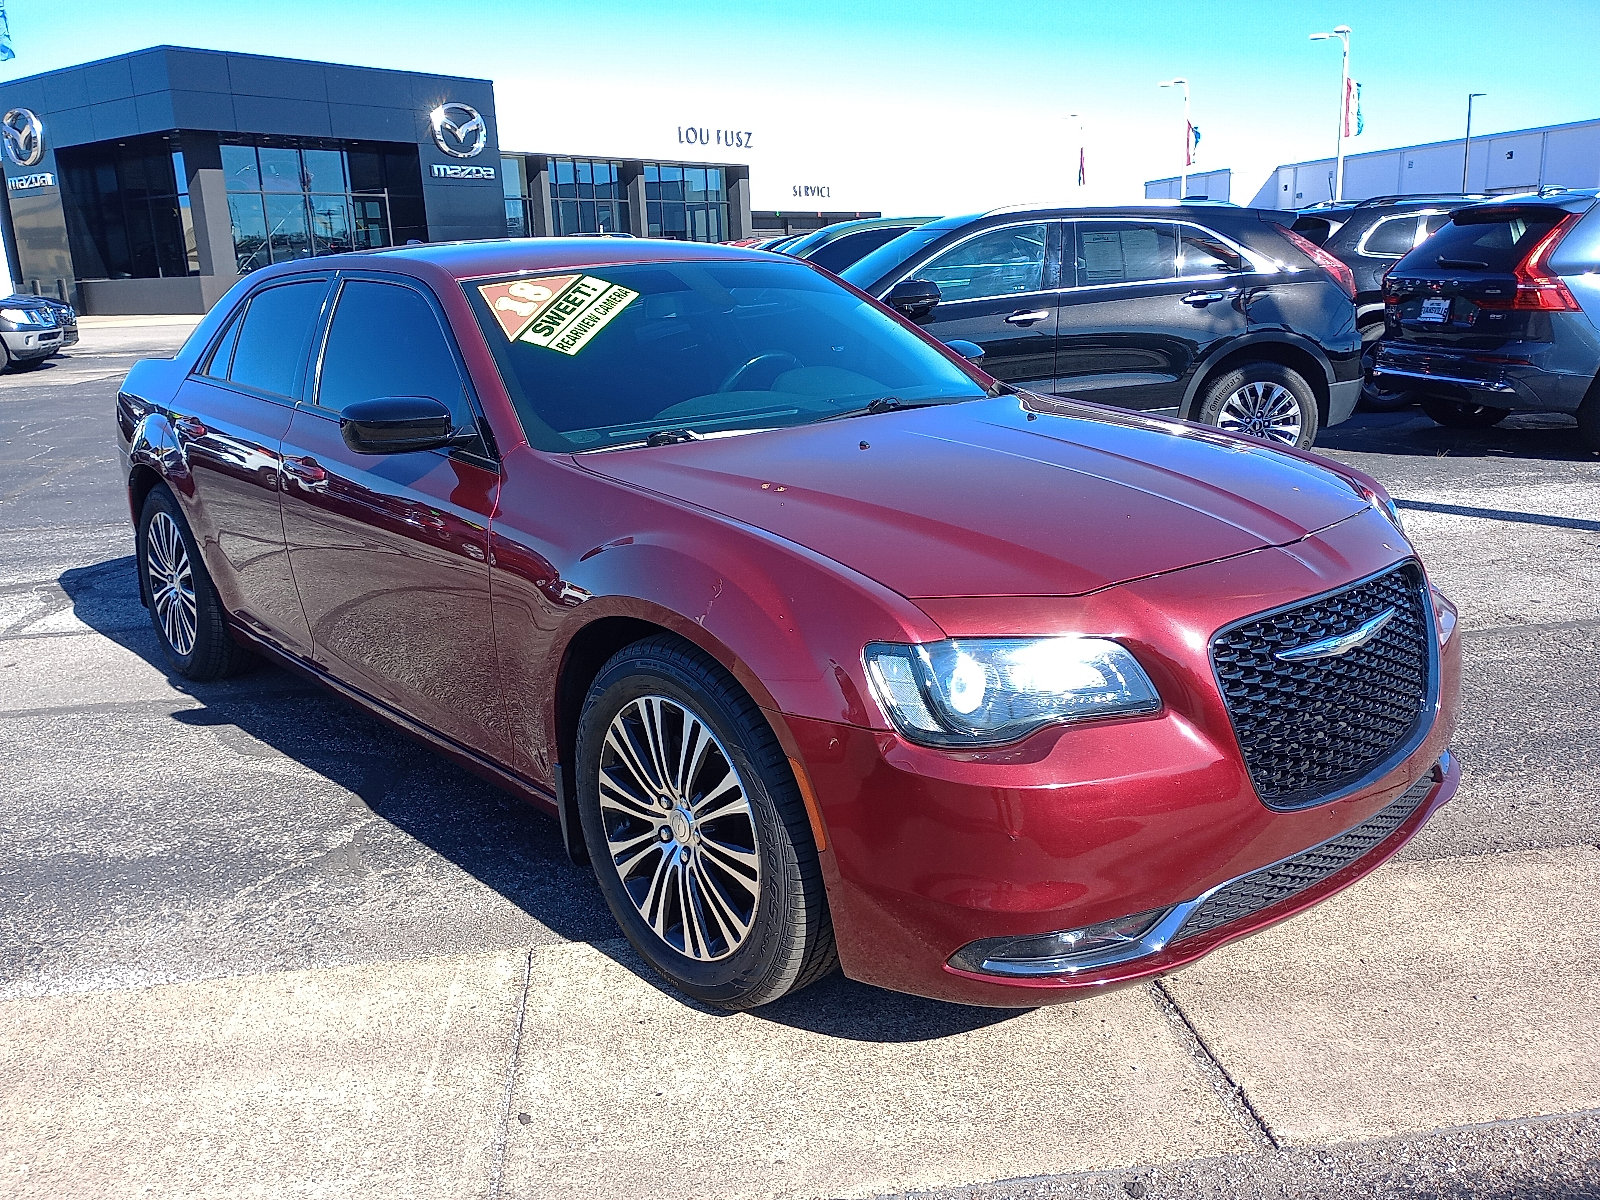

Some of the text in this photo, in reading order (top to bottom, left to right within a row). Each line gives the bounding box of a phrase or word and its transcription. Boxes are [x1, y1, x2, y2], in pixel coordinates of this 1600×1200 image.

[678, 126, 754, 148] LOU FUSZ
[430, 164, 496, 180] mazda
[494, 282, 553, 317] 18
[532, 283, 598, 337] SWEET!
[556, 288, 630, 351] REARVIEW CAMERA
